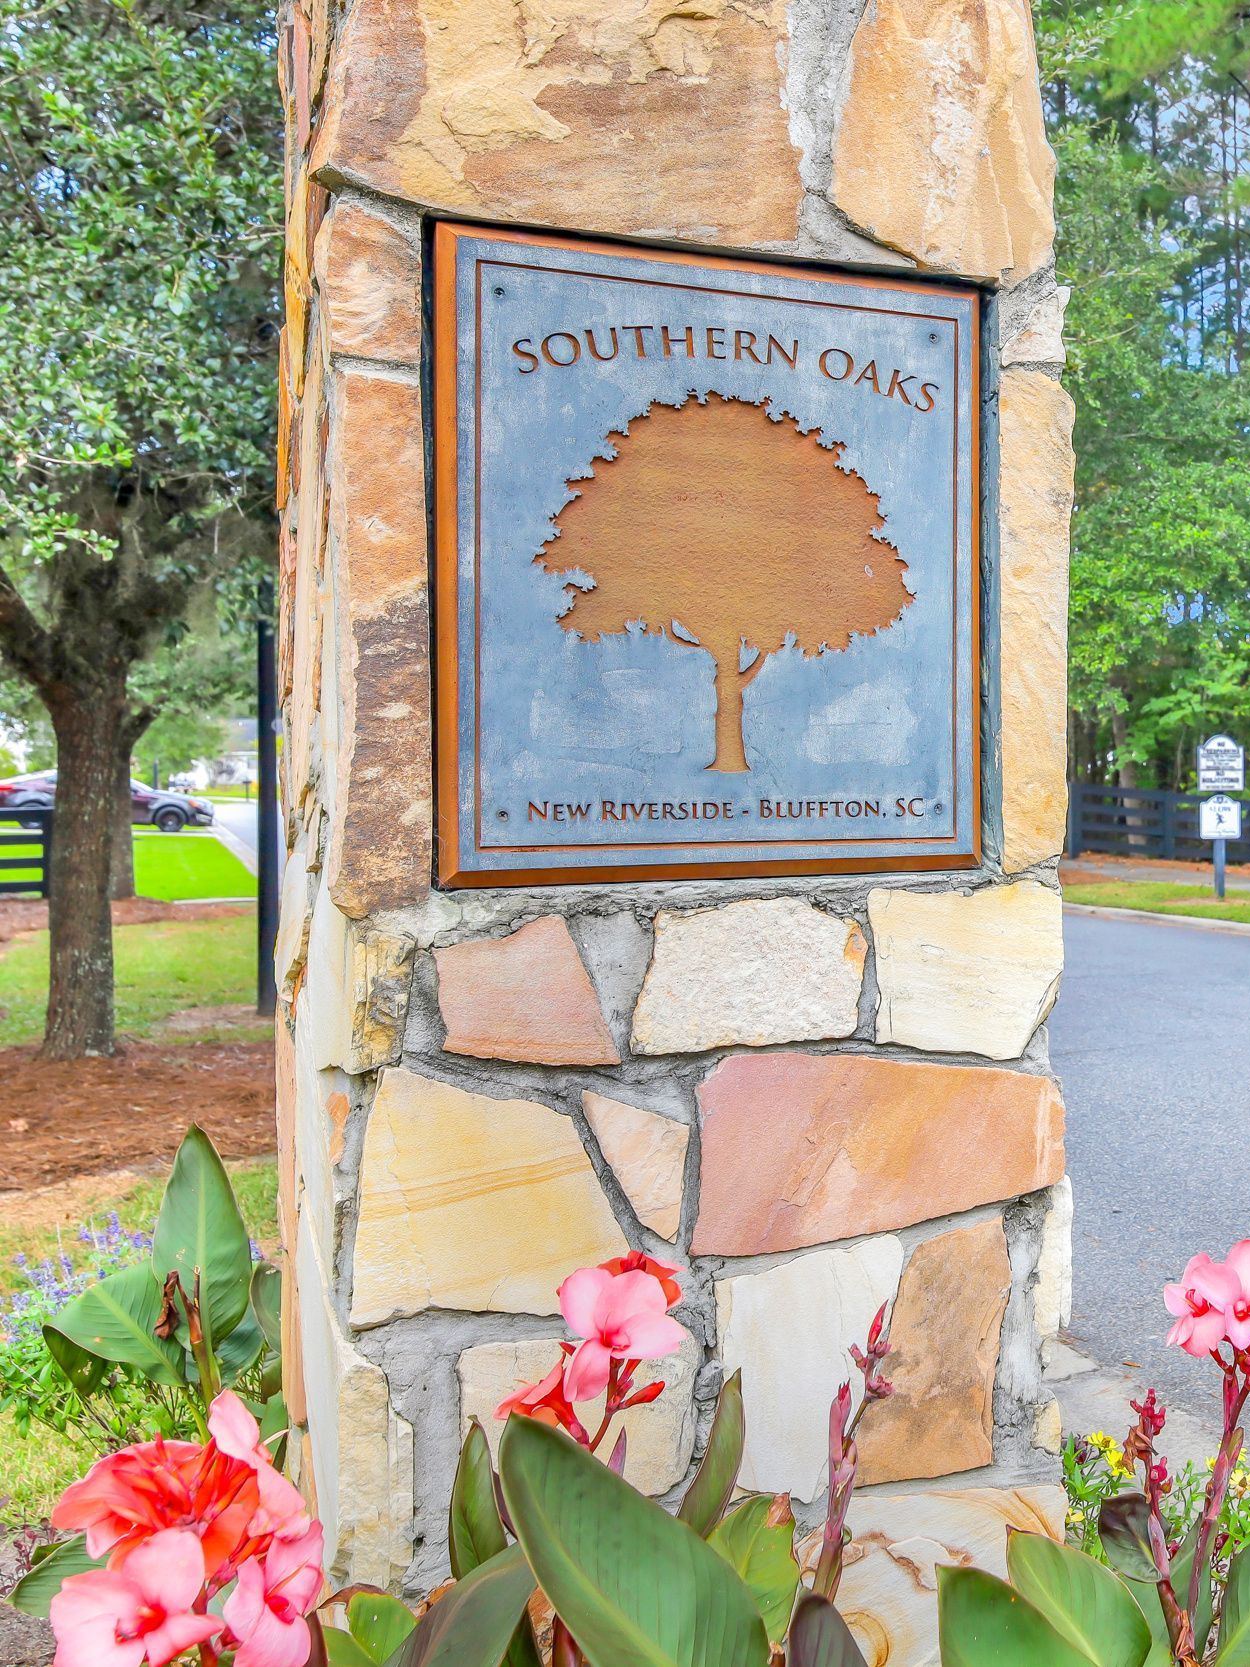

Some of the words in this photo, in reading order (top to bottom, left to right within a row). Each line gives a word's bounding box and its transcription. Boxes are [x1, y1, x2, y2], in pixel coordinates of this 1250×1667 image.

[511, 325, 799, 374] SOUTHERN
[819, 348, 939, 412] OAKS
[895, 798, 925, 818] SC
